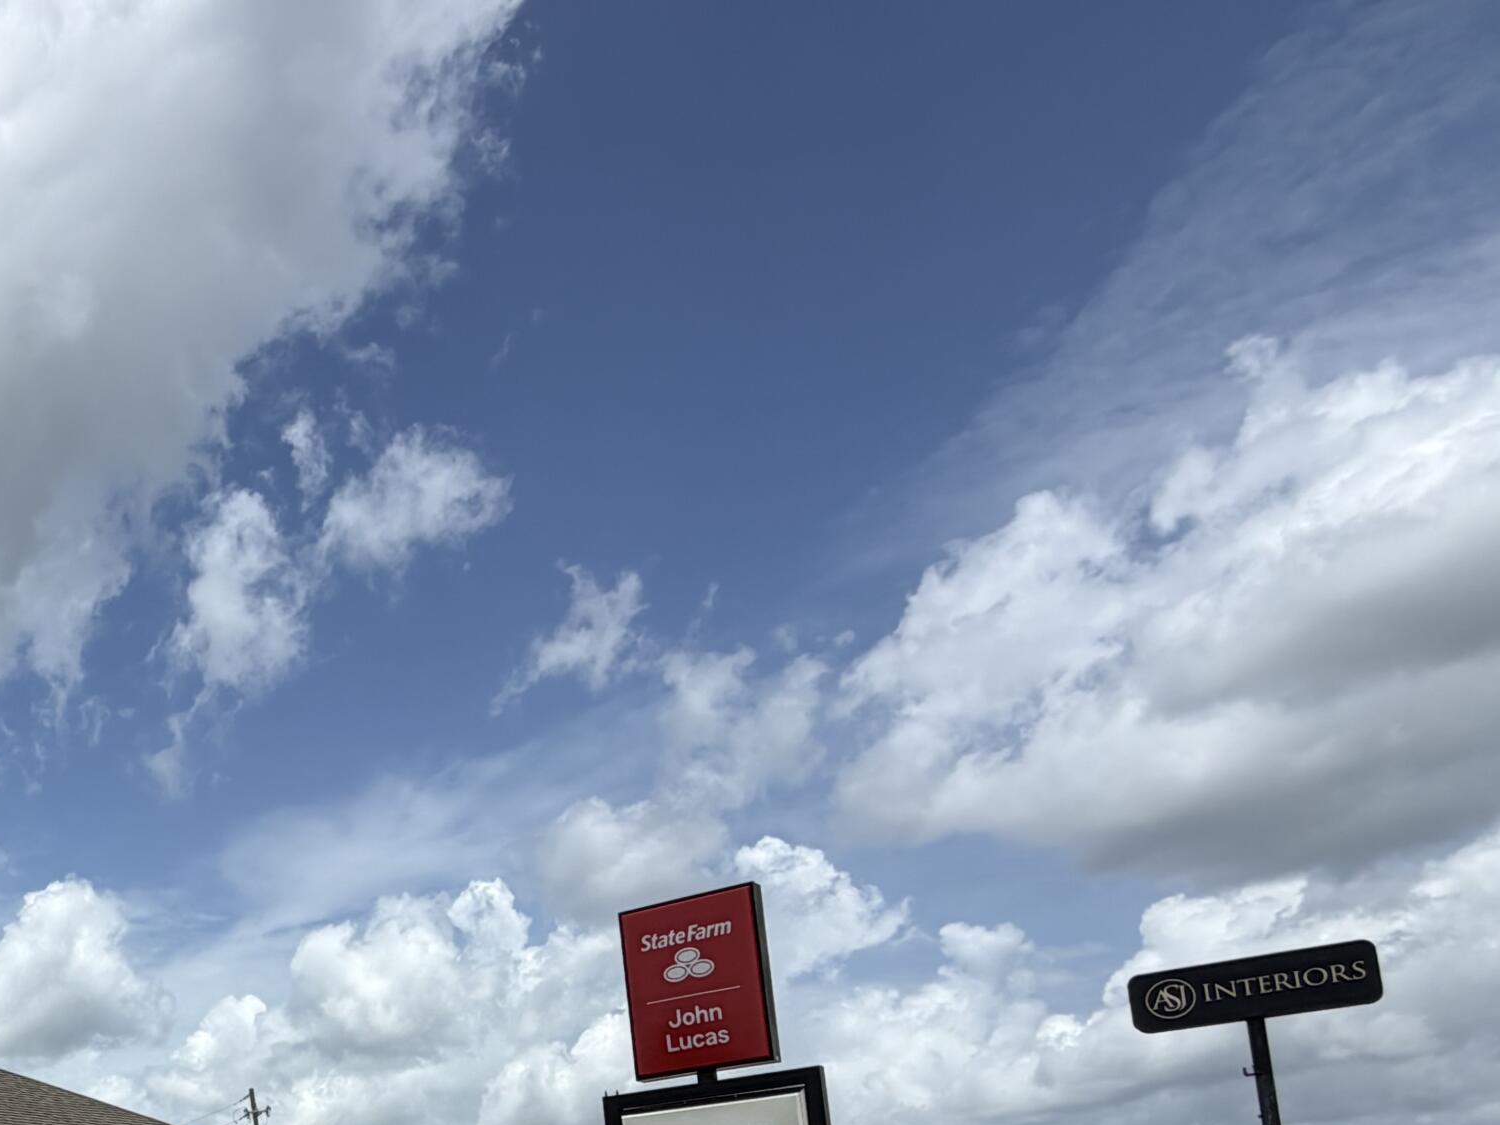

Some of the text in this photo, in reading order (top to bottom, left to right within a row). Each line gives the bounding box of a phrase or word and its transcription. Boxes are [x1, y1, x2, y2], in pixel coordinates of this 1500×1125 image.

[1202, 960, 1367, 1002] INTERIORS
[668, 1005, 723, 1028] John
[666, 1029, 730, 1053] Lucas
